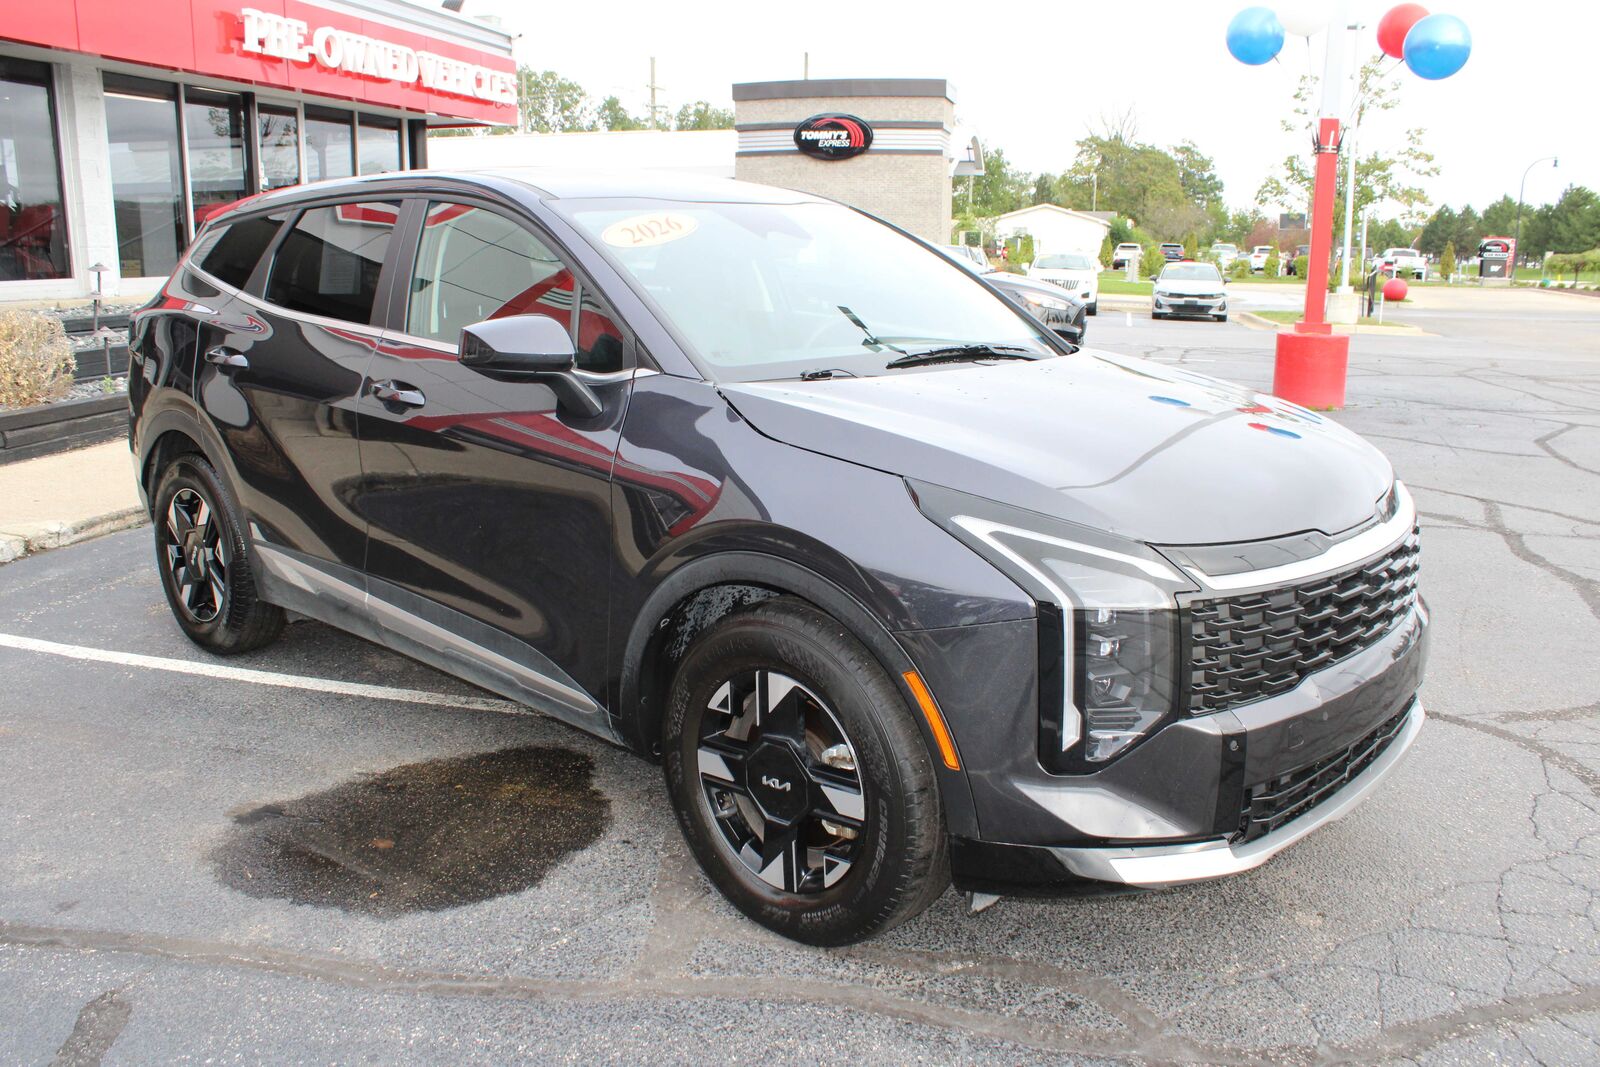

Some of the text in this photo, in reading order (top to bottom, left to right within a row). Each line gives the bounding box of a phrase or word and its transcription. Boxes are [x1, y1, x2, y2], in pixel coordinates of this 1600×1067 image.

[242, 8, 518, 105] PRE-OWNED VEHICLES
[801, 130, 849, 140] TOMMY'S
[818, 139, 851, 148] EXPRESS
[620, 216, 683, 244] 2026
